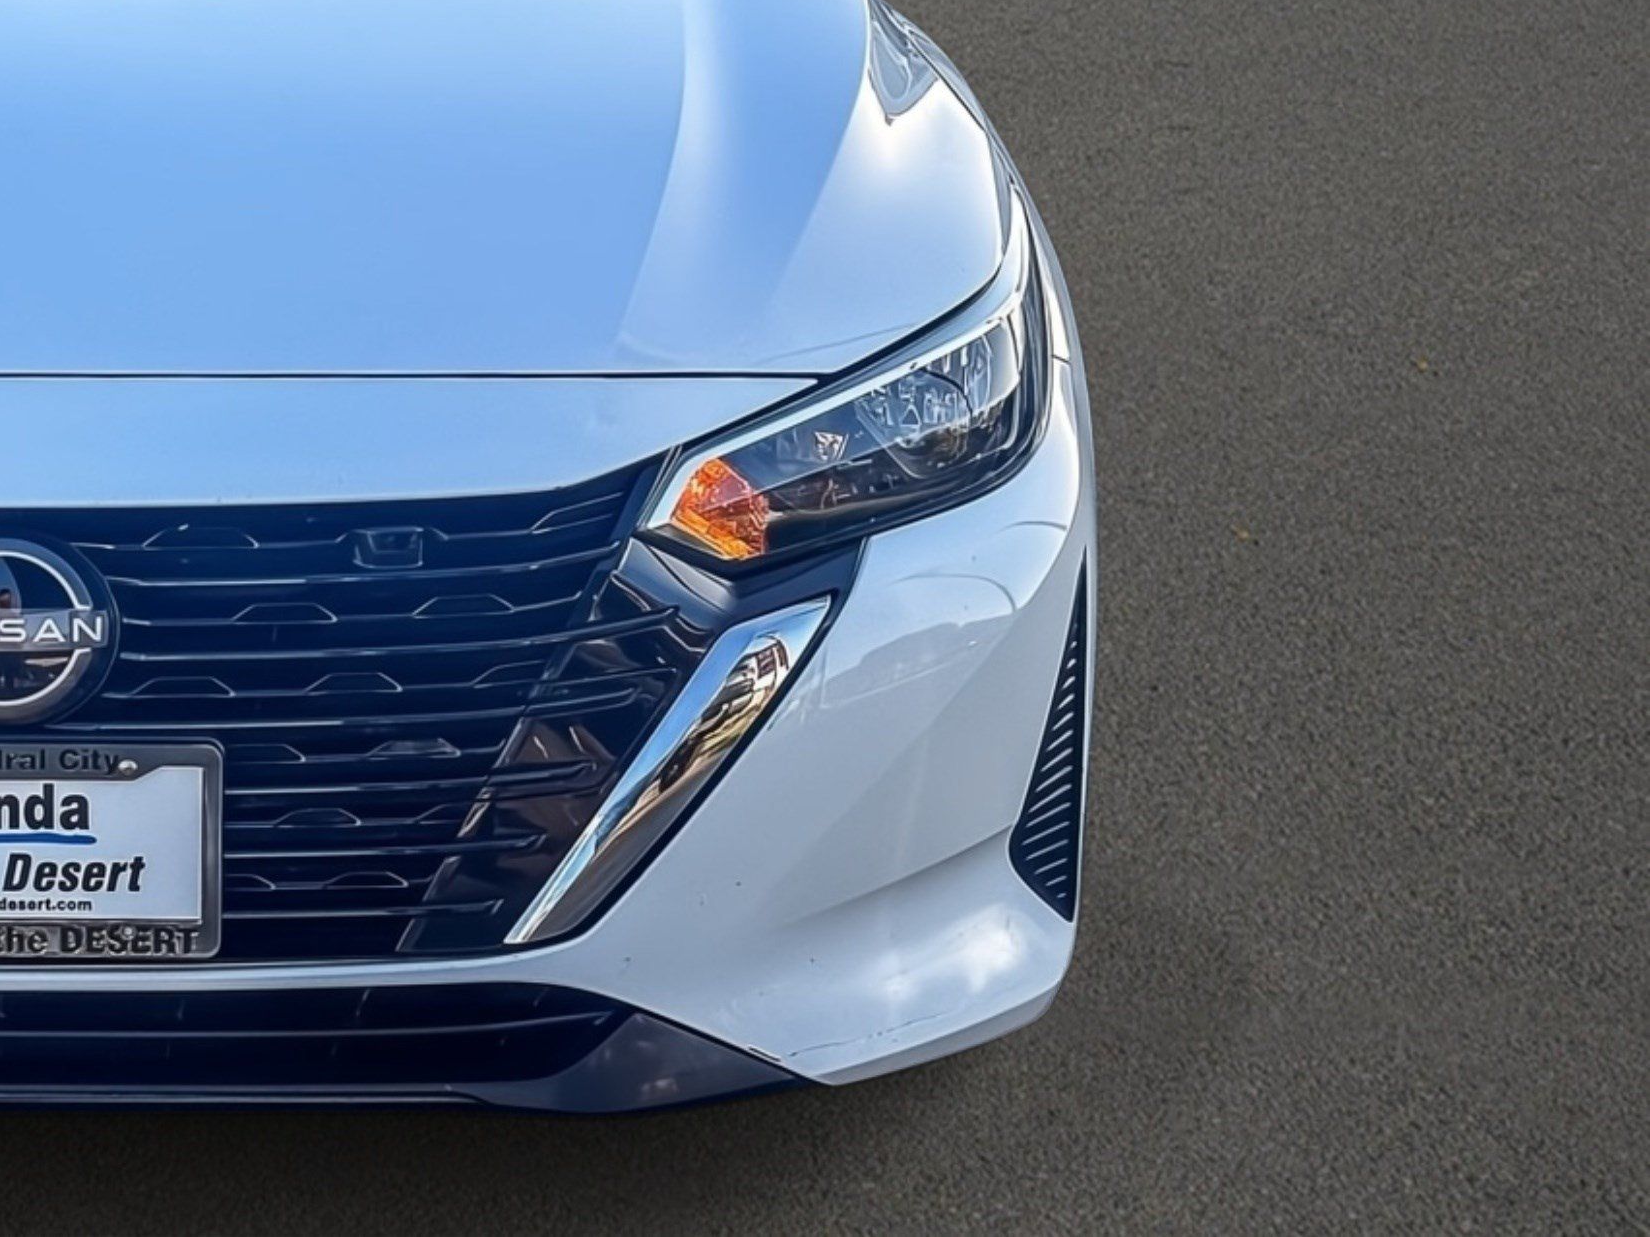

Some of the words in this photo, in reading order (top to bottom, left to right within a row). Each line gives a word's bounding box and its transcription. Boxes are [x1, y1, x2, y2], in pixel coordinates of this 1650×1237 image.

[58, 747, 121, 775] City
[3, 853, 146, 892] Desert
[60, 925, 198, 954] DESERT
